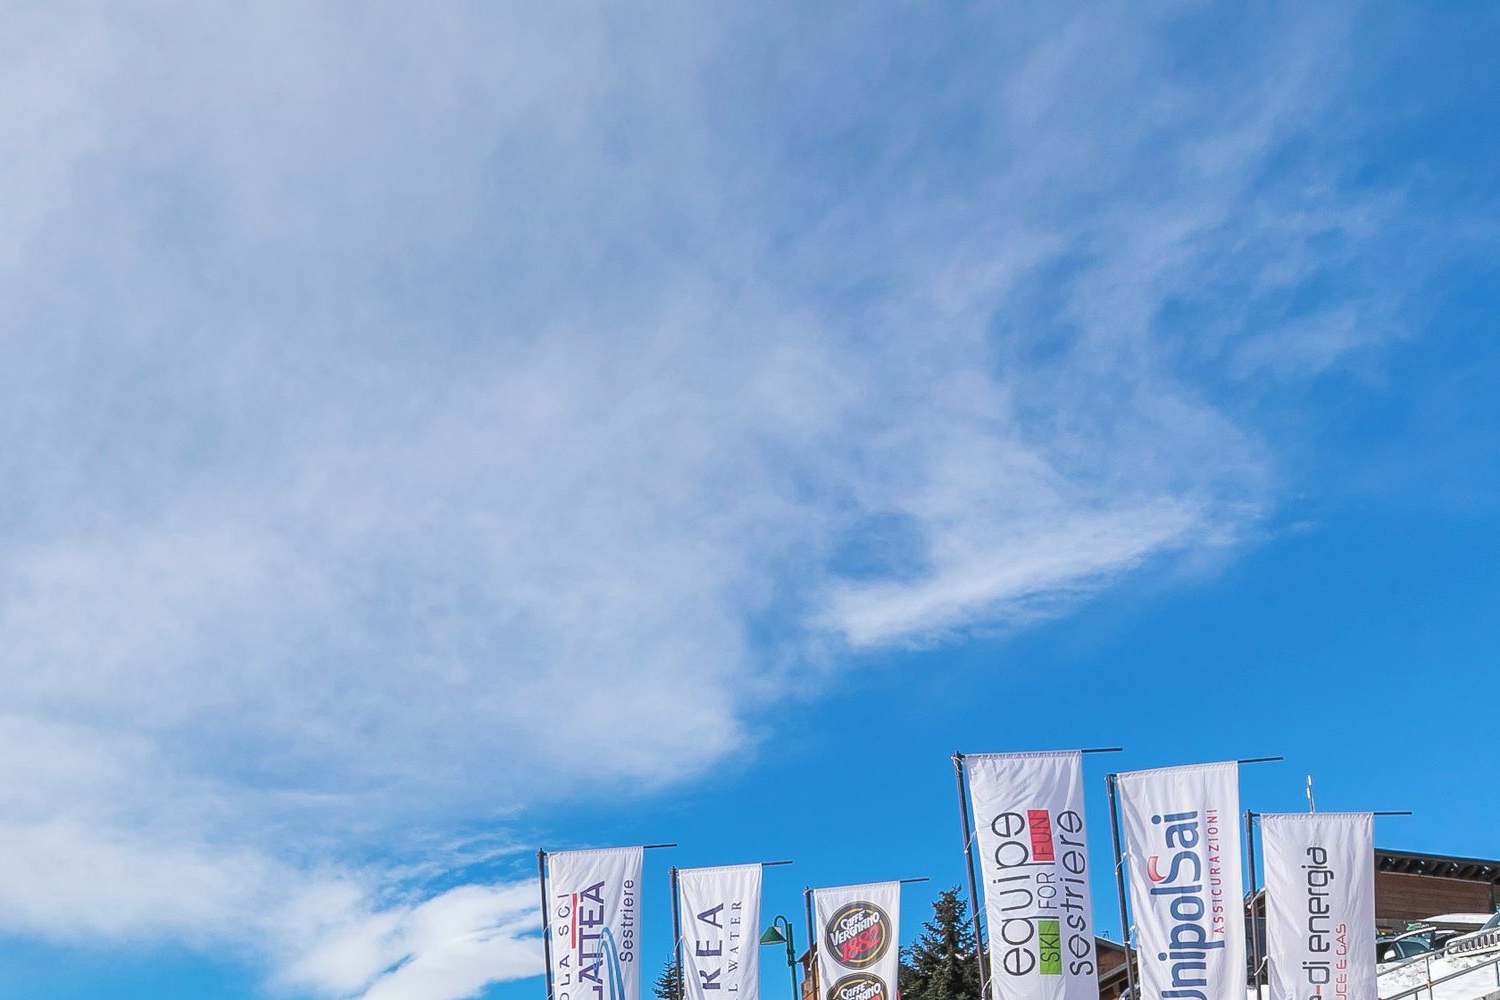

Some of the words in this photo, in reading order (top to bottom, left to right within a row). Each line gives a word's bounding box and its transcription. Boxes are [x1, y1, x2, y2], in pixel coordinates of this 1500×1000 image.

[1029, 815, 1054, 857] FUN
[1036, 872, 1058, 909] FOR
[1207, 809, 1225, 934] ASSICURAZIONI
[991, 812, 1060, 977] equipe
[1057, 810, 1094, 976] sestriere
[1302, 846, 1334, 953] energia
[557, 894, 571, 936] SCI
[620, 879, 635, 962] Sestriere
[830, 911, 880, 946] VERGNANO
[728, 901, 742, 973] WATER
[839, 924, 880, 963] 1882
[1039, 932, 1061, 963] SKI
[1336, 923, 1347, 956] GAS
[1337, 959, 1347, 970] E
